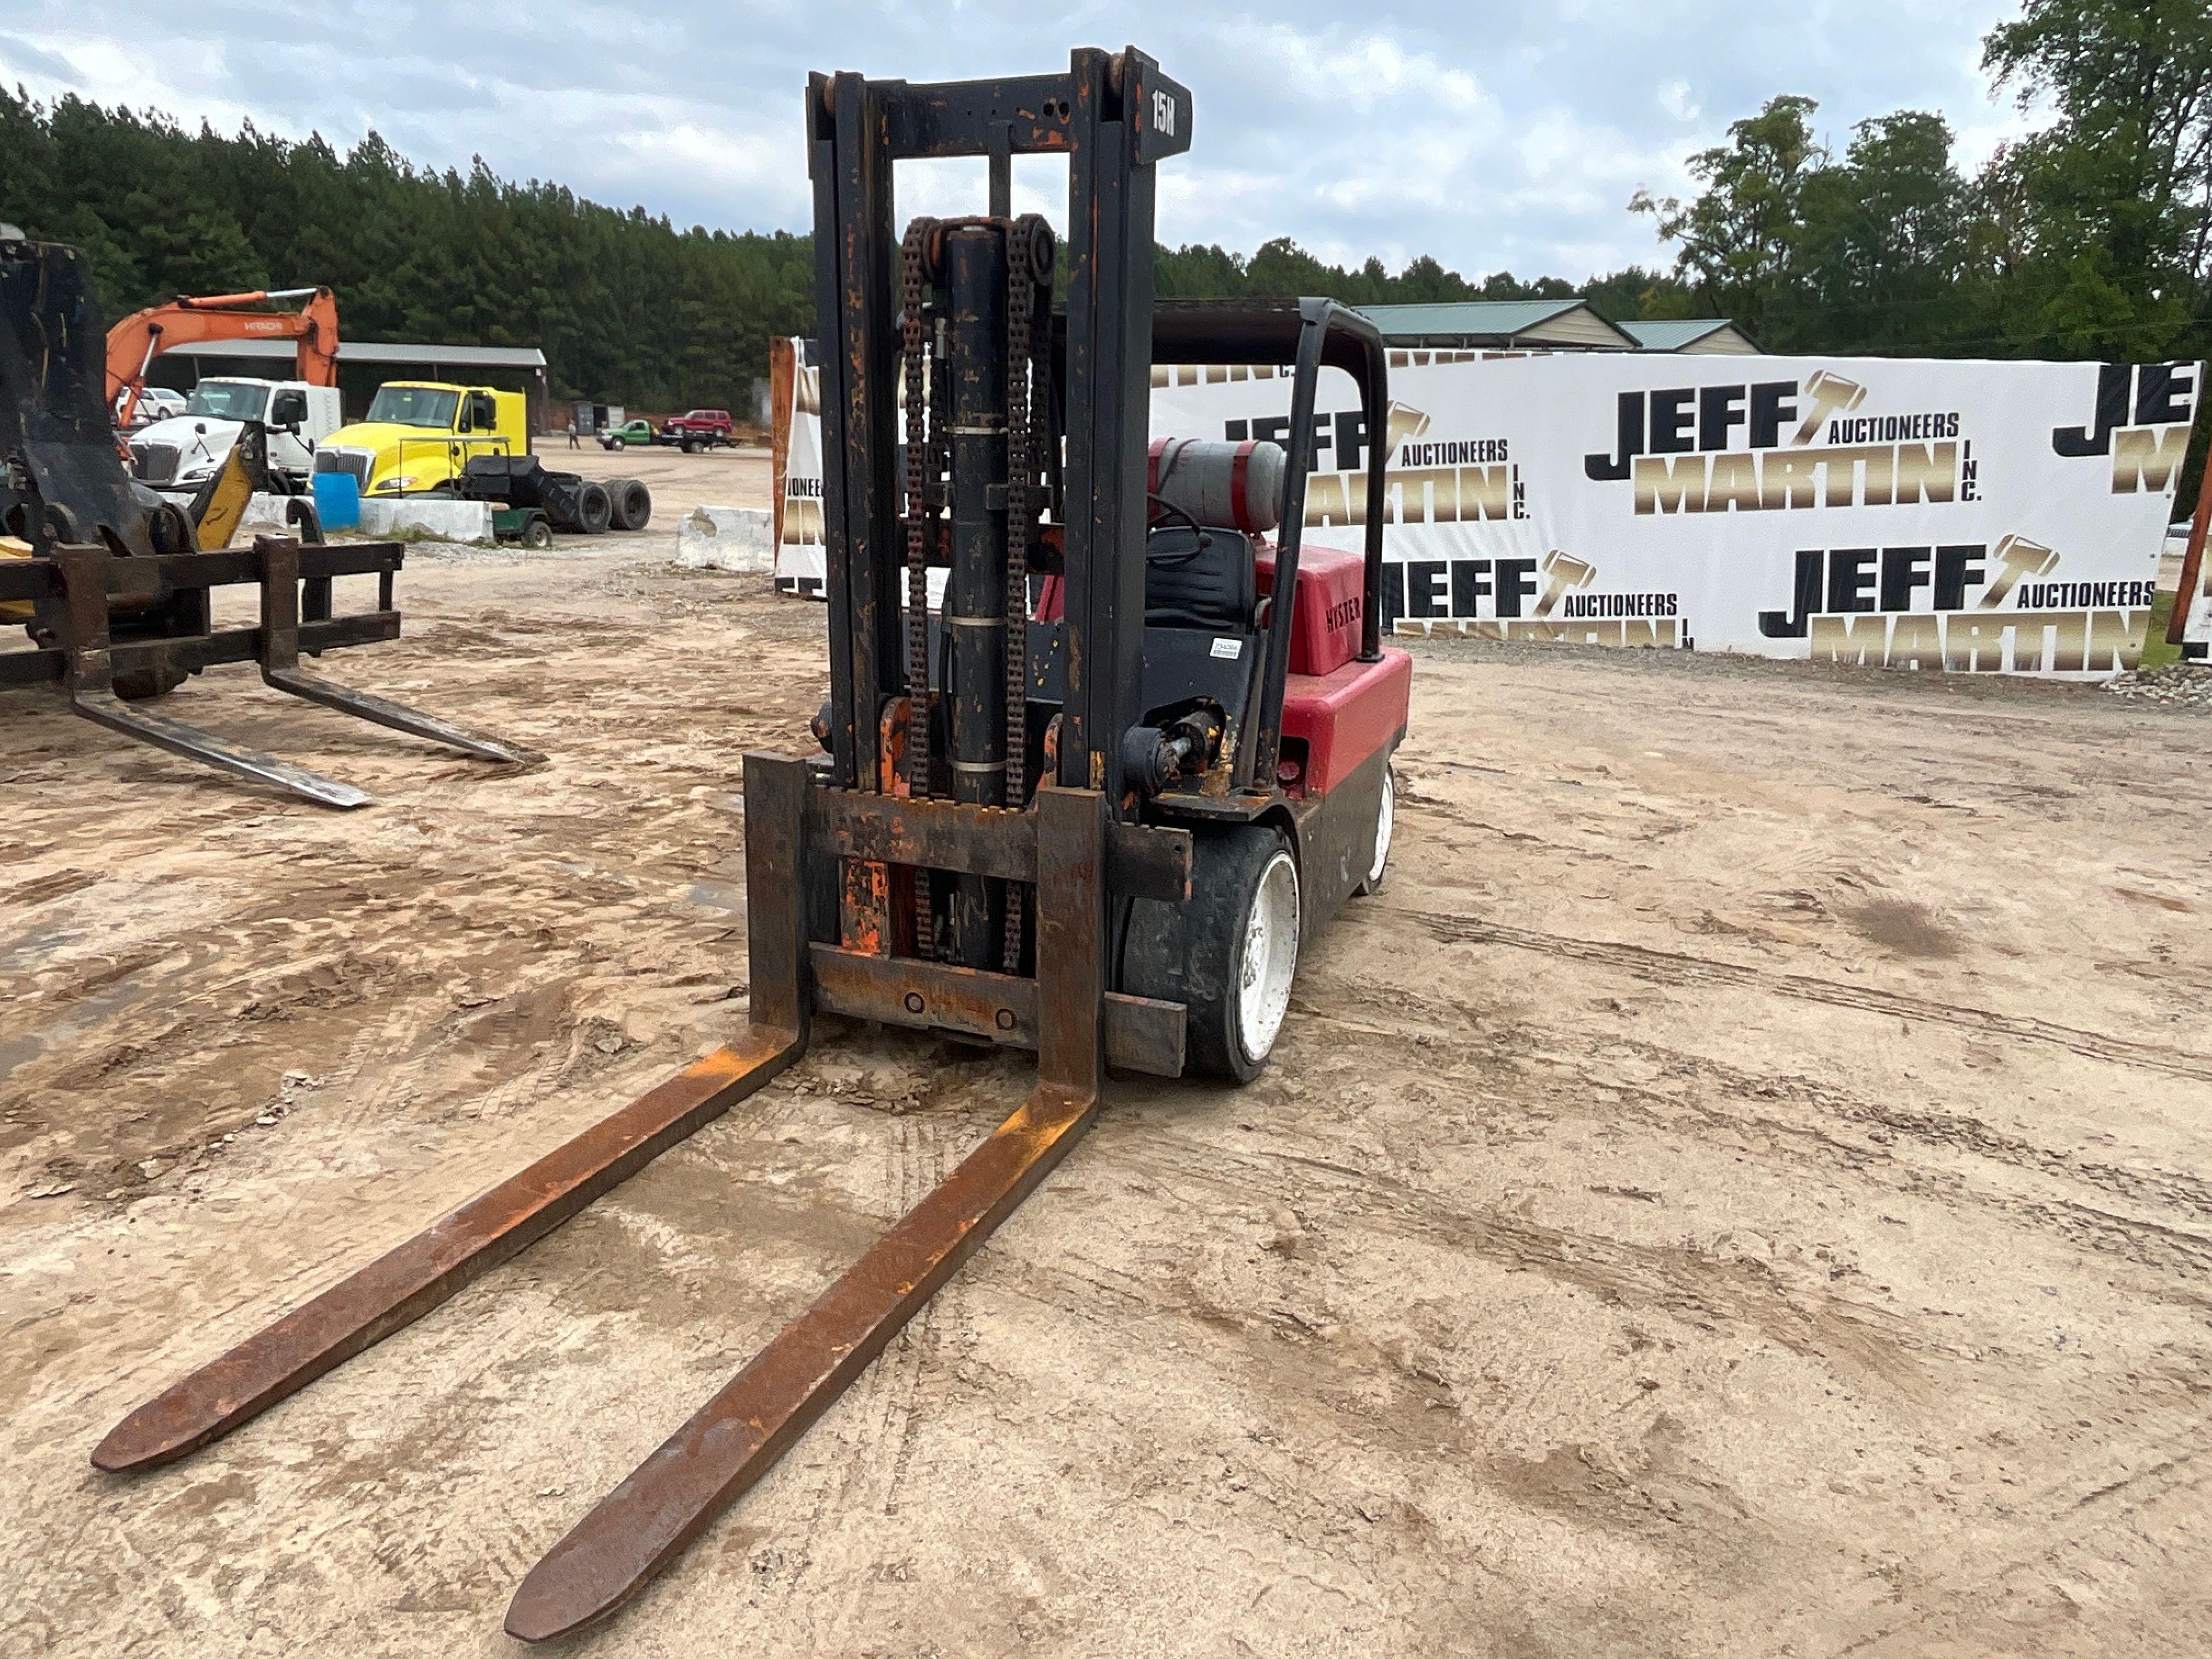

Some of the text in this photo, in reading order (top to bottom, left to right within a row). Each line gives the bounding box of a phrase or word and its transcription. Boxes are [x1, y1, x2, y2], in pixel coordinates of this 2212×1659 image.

[1152, 89, 1175, 137] 15H
[1402, 439, 1509, 467] AUCTIONEERS
[1584, 381, 1798, 481] JEFF
[1828, 413, 1960, 444] AUCTIONEERS
[1304, 466, 1508, 527] ARTIN
[1513, 464, 1531, 520] INC.
[1634, 441, 1957, 516] MARTIN
[1962, 440, 1982, 501] INC.
[1325, 597, 1361, 633] HYSTER
[1564, 594, 1678, 618] AUCTIONEERS
[1759, 544, 1987, 639] JEFF
[2017, 582, 2155, 609] AUCTIONEERS
[1810, 610, 2152, 672] MARTIN
